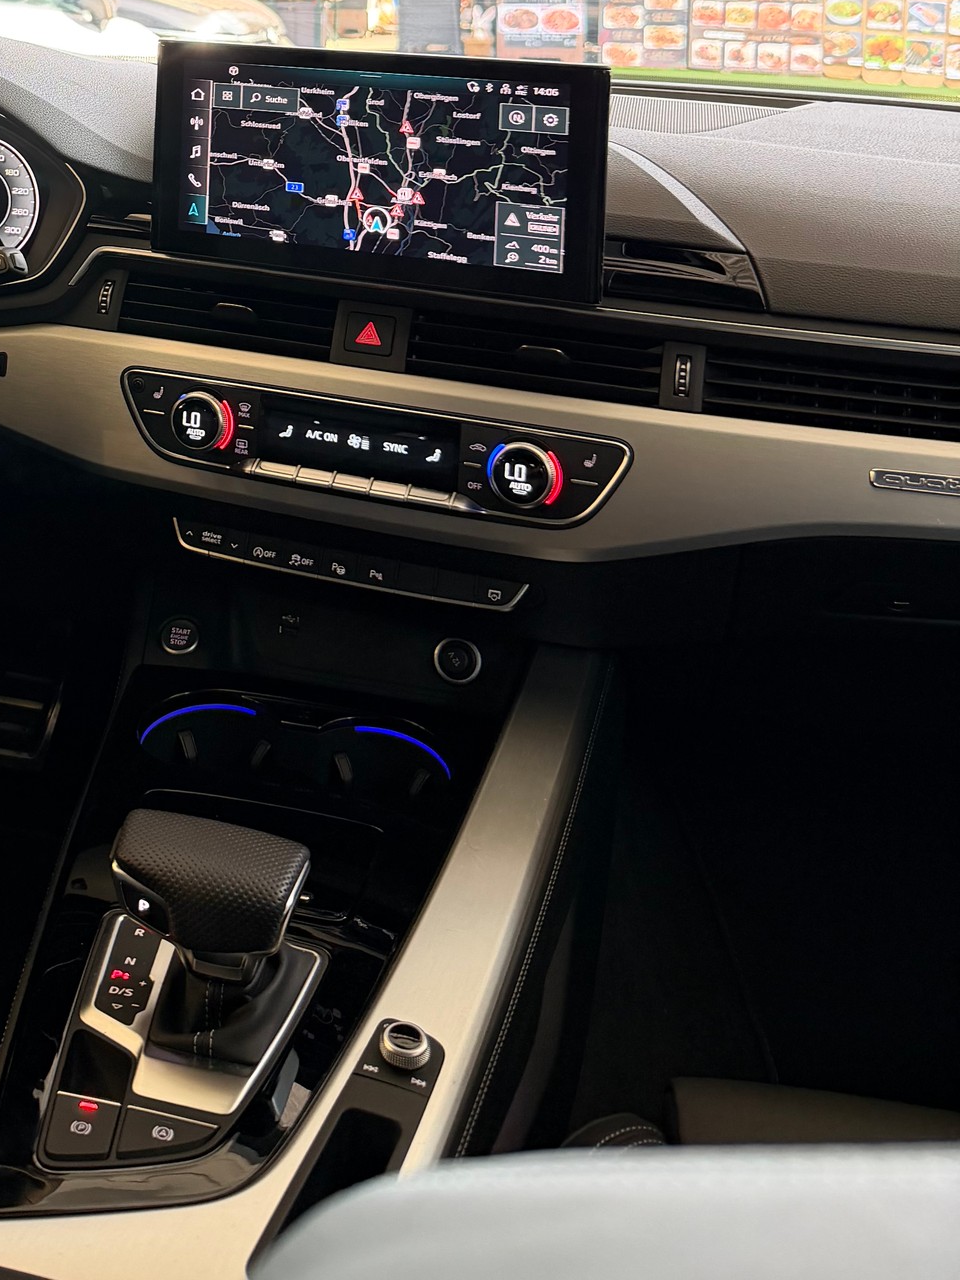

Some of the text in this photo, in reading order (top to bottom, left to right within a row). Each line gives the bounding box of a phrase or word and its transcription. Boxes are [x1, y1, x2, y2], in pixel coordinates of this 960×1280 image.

[265, 95, 288, 104] Suche
[453, 111, 481, 120] Lostorf
[240, 120, 281, 130] Schlossrued
[5, 168, 19, 177] 180
[11, 187, 29, 195] 220
[4, 226, 21, 234] 300
[182, 410, 201, 428] LO
[238, 411, 251, 419] MAX
[186, 428, 206, 437] AUTO
[305, 429, 338, 443] A/C ON
[382, 441, 409, 455] SYNC
[504, 462, 527, 482] LO
[467, 481, 483, 491] OFF
[509, 482, 532, 492] AUTO
[202, 530, 222, 540] drive
[201, 535, 221, 545] select
[264, 550, 277, 558] OFF
[301, 558, 314, 567] OFF
[171, 627, 191, 635] START
[138, 898, 150, 911] P
[134, 928, 145, 937] R
[124, 957, 137, 966] N
[108, 986, 134, 997] D/S
